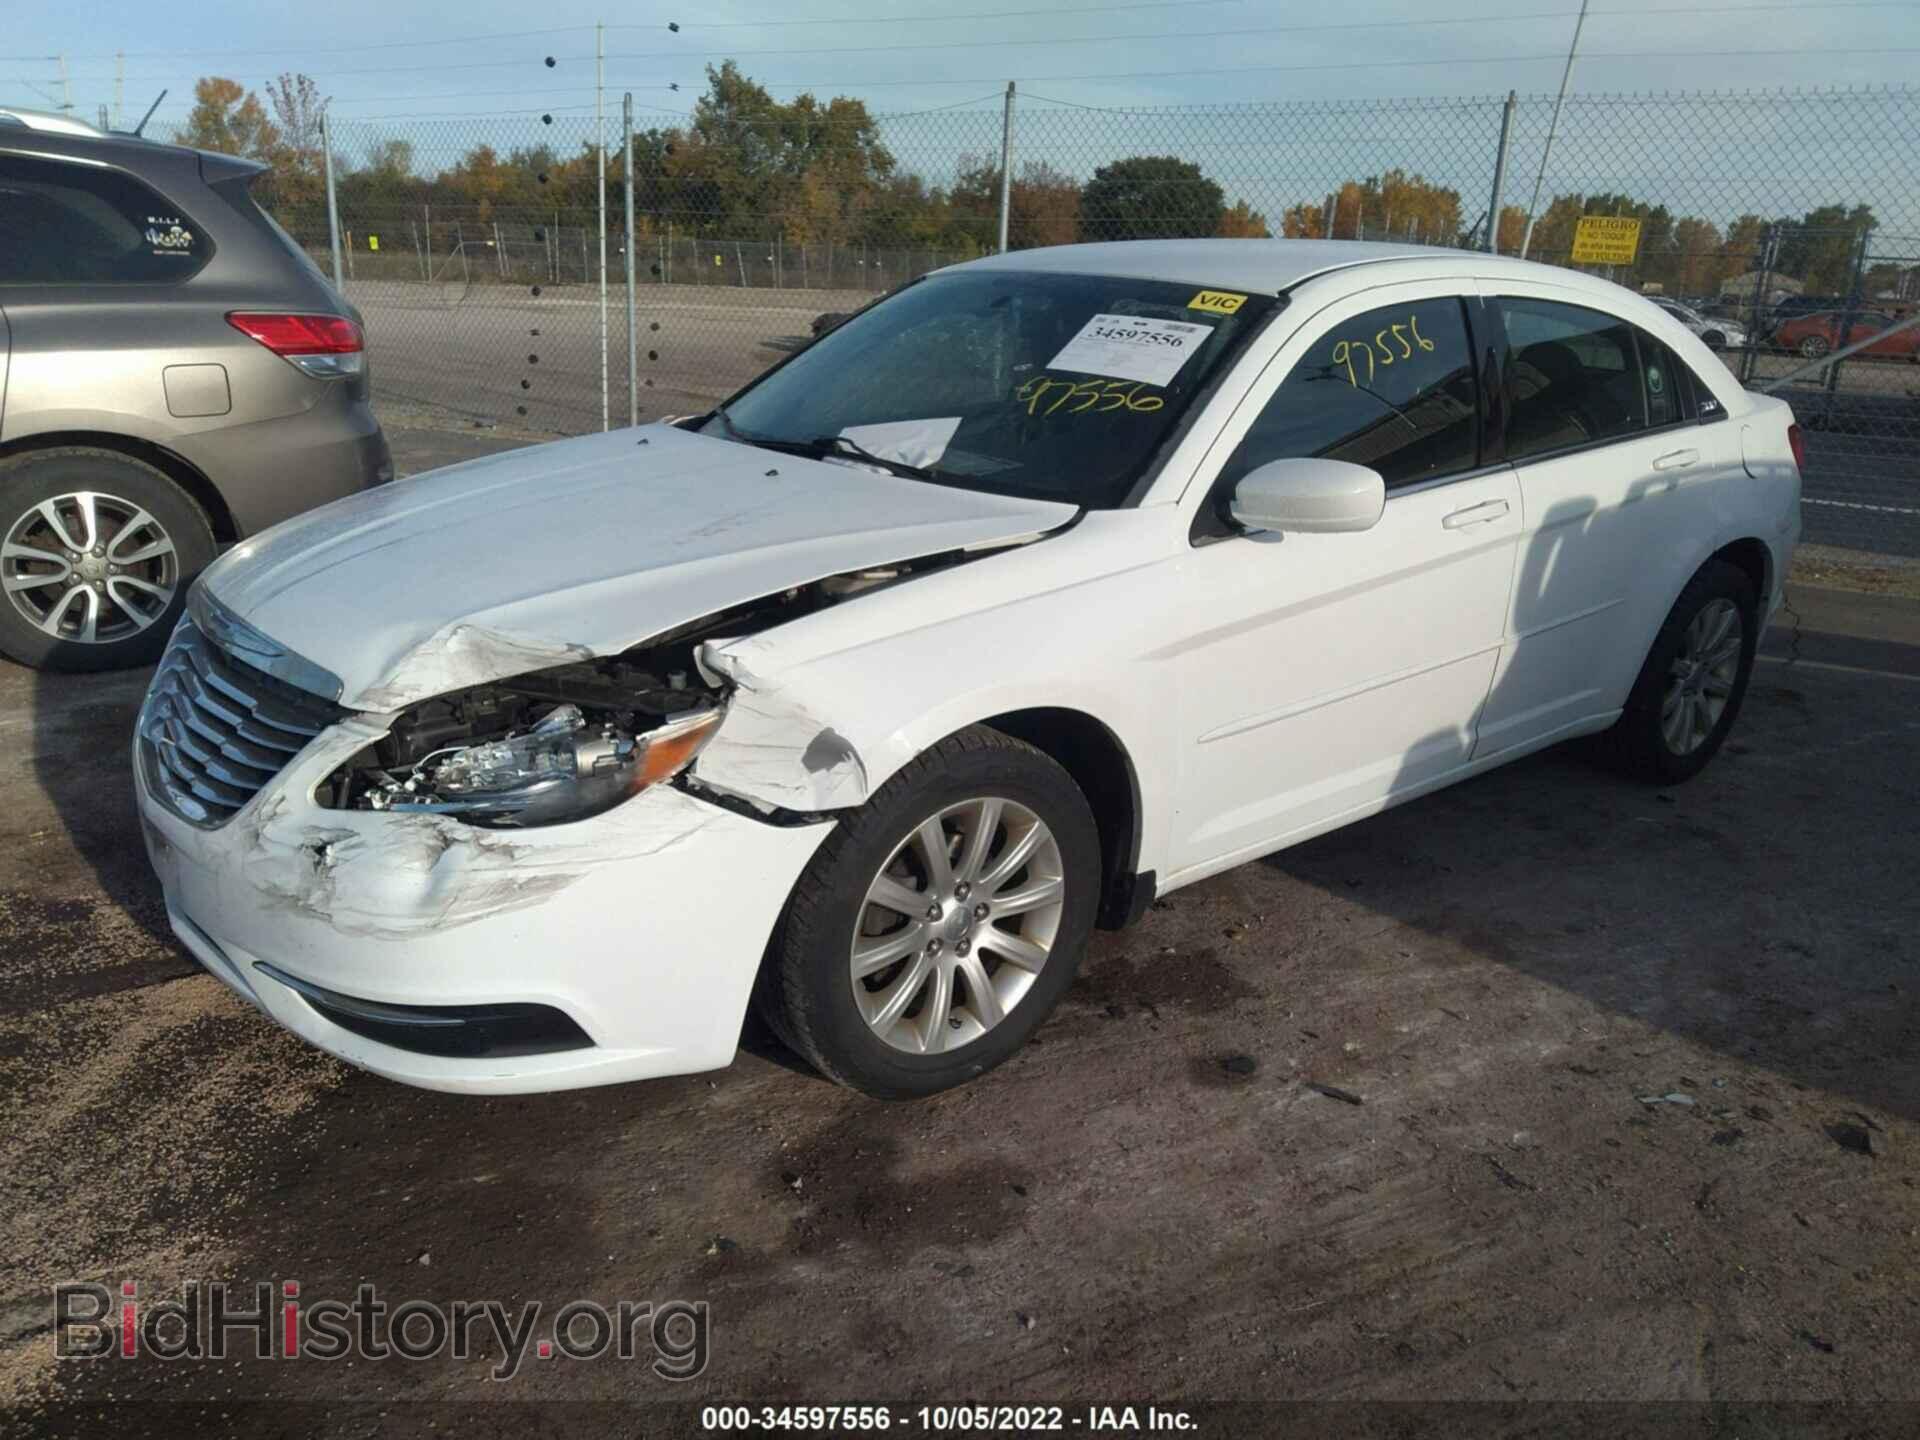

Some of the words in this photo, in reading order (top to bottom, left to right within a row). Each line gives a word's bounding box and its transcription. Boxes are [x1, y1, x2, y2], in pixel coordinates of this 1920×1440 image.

[1582, 218, 1638, 231] PELIGRO
[1198, 293, 1239, 310] VIC
[1088, 326, 1184, 348] 34597556
[1332, 315, 1435, 388] 97556
[1016, 376, 1164, 416] 97556
